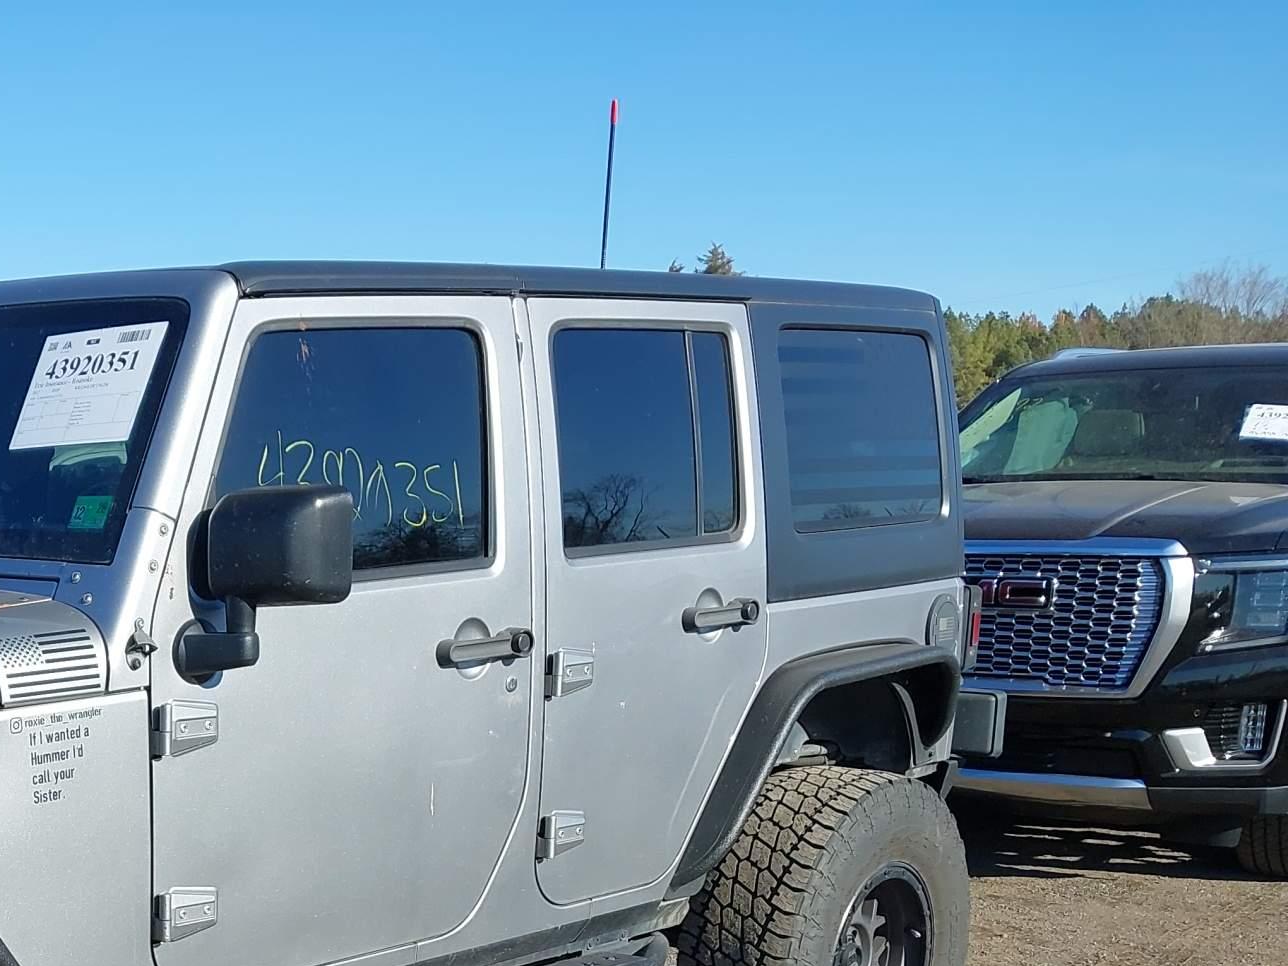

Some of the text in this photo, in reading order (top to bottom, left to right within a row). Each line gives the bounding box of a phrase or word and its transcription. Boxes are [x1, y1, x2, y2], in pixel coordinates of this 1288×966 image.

[45, 349, 140, 380] 43920351
[29, 731, 37, 747] If
[45, 725, 81, 744] wanted
[84, 726, 90, 738] a
[30, 749, 70, 767] Hummer
[32, 768, 75, 786] call your
